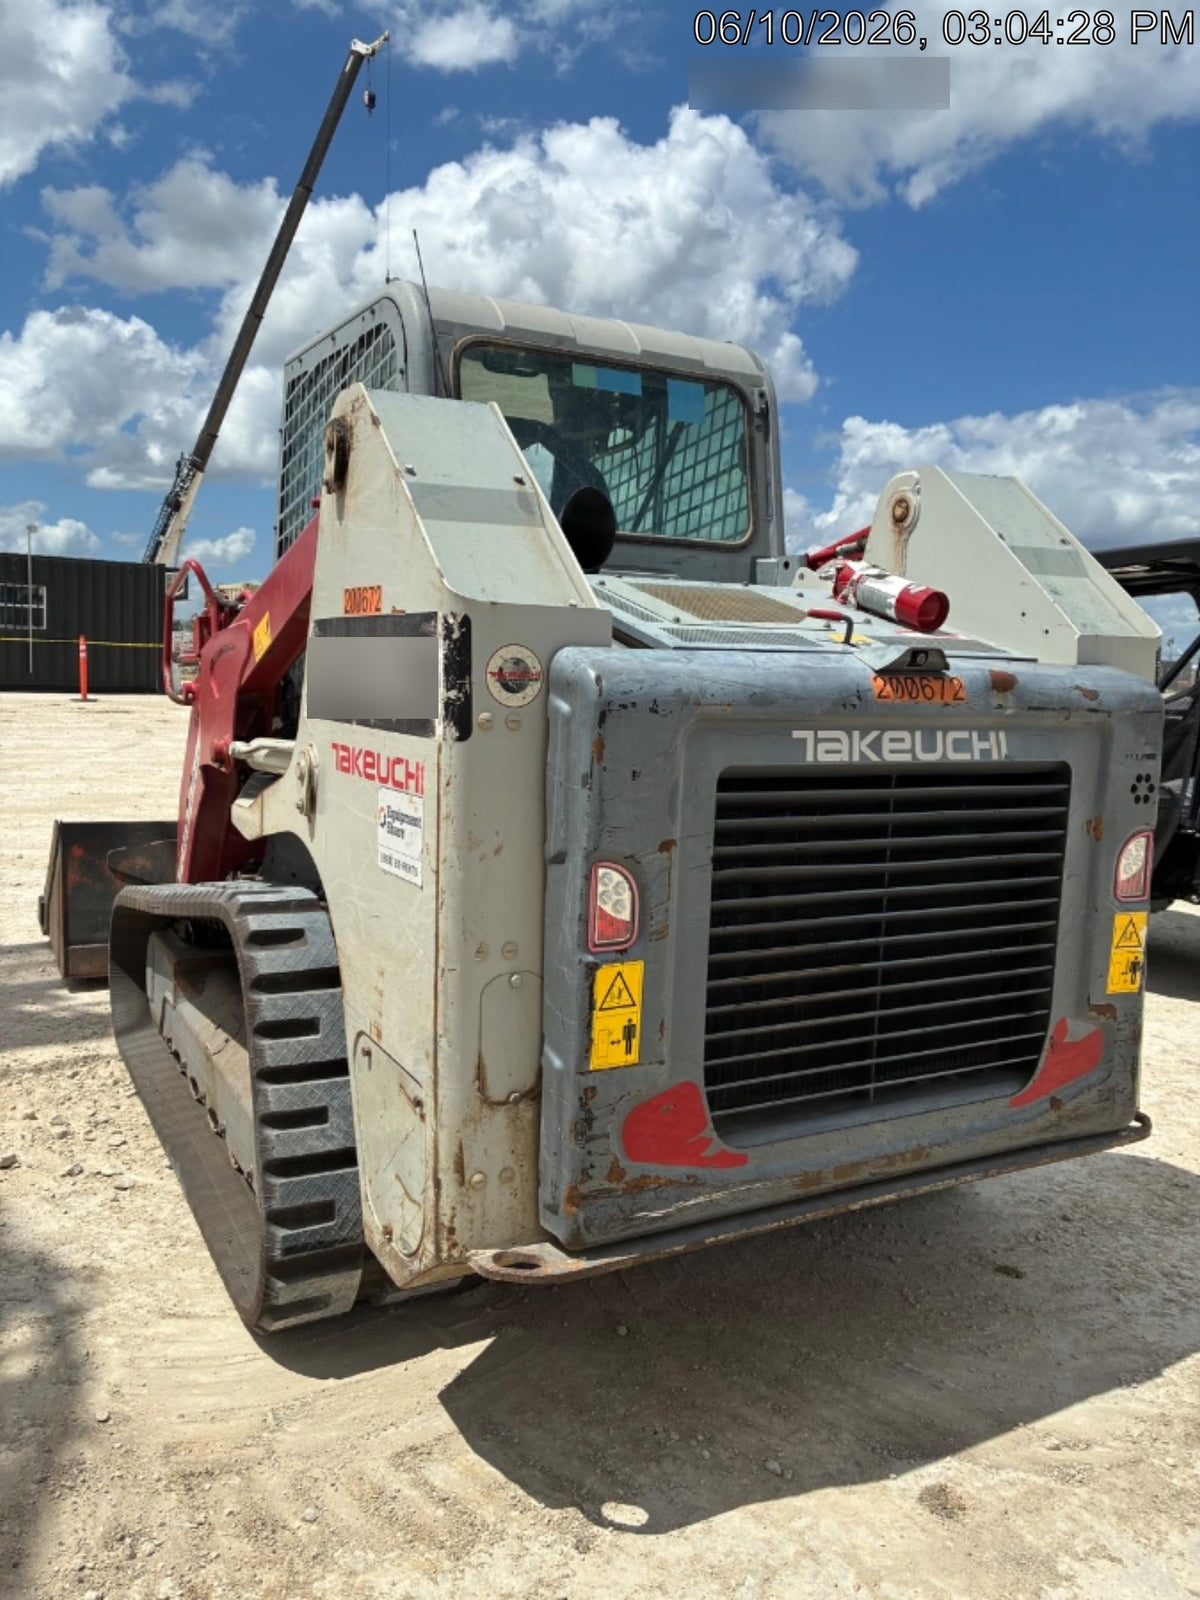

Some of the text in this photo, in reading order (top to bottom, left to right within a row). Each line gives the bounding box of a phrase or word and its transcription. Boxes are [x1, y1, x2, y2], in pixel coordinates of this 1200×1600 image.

[344, 584, 382, 614] 200672
[872, 674, 966, 702] 200672
[791, 729, 1008, 763] TAKEUCHI
[331, 742, 424, 796] TAKEUCHI
